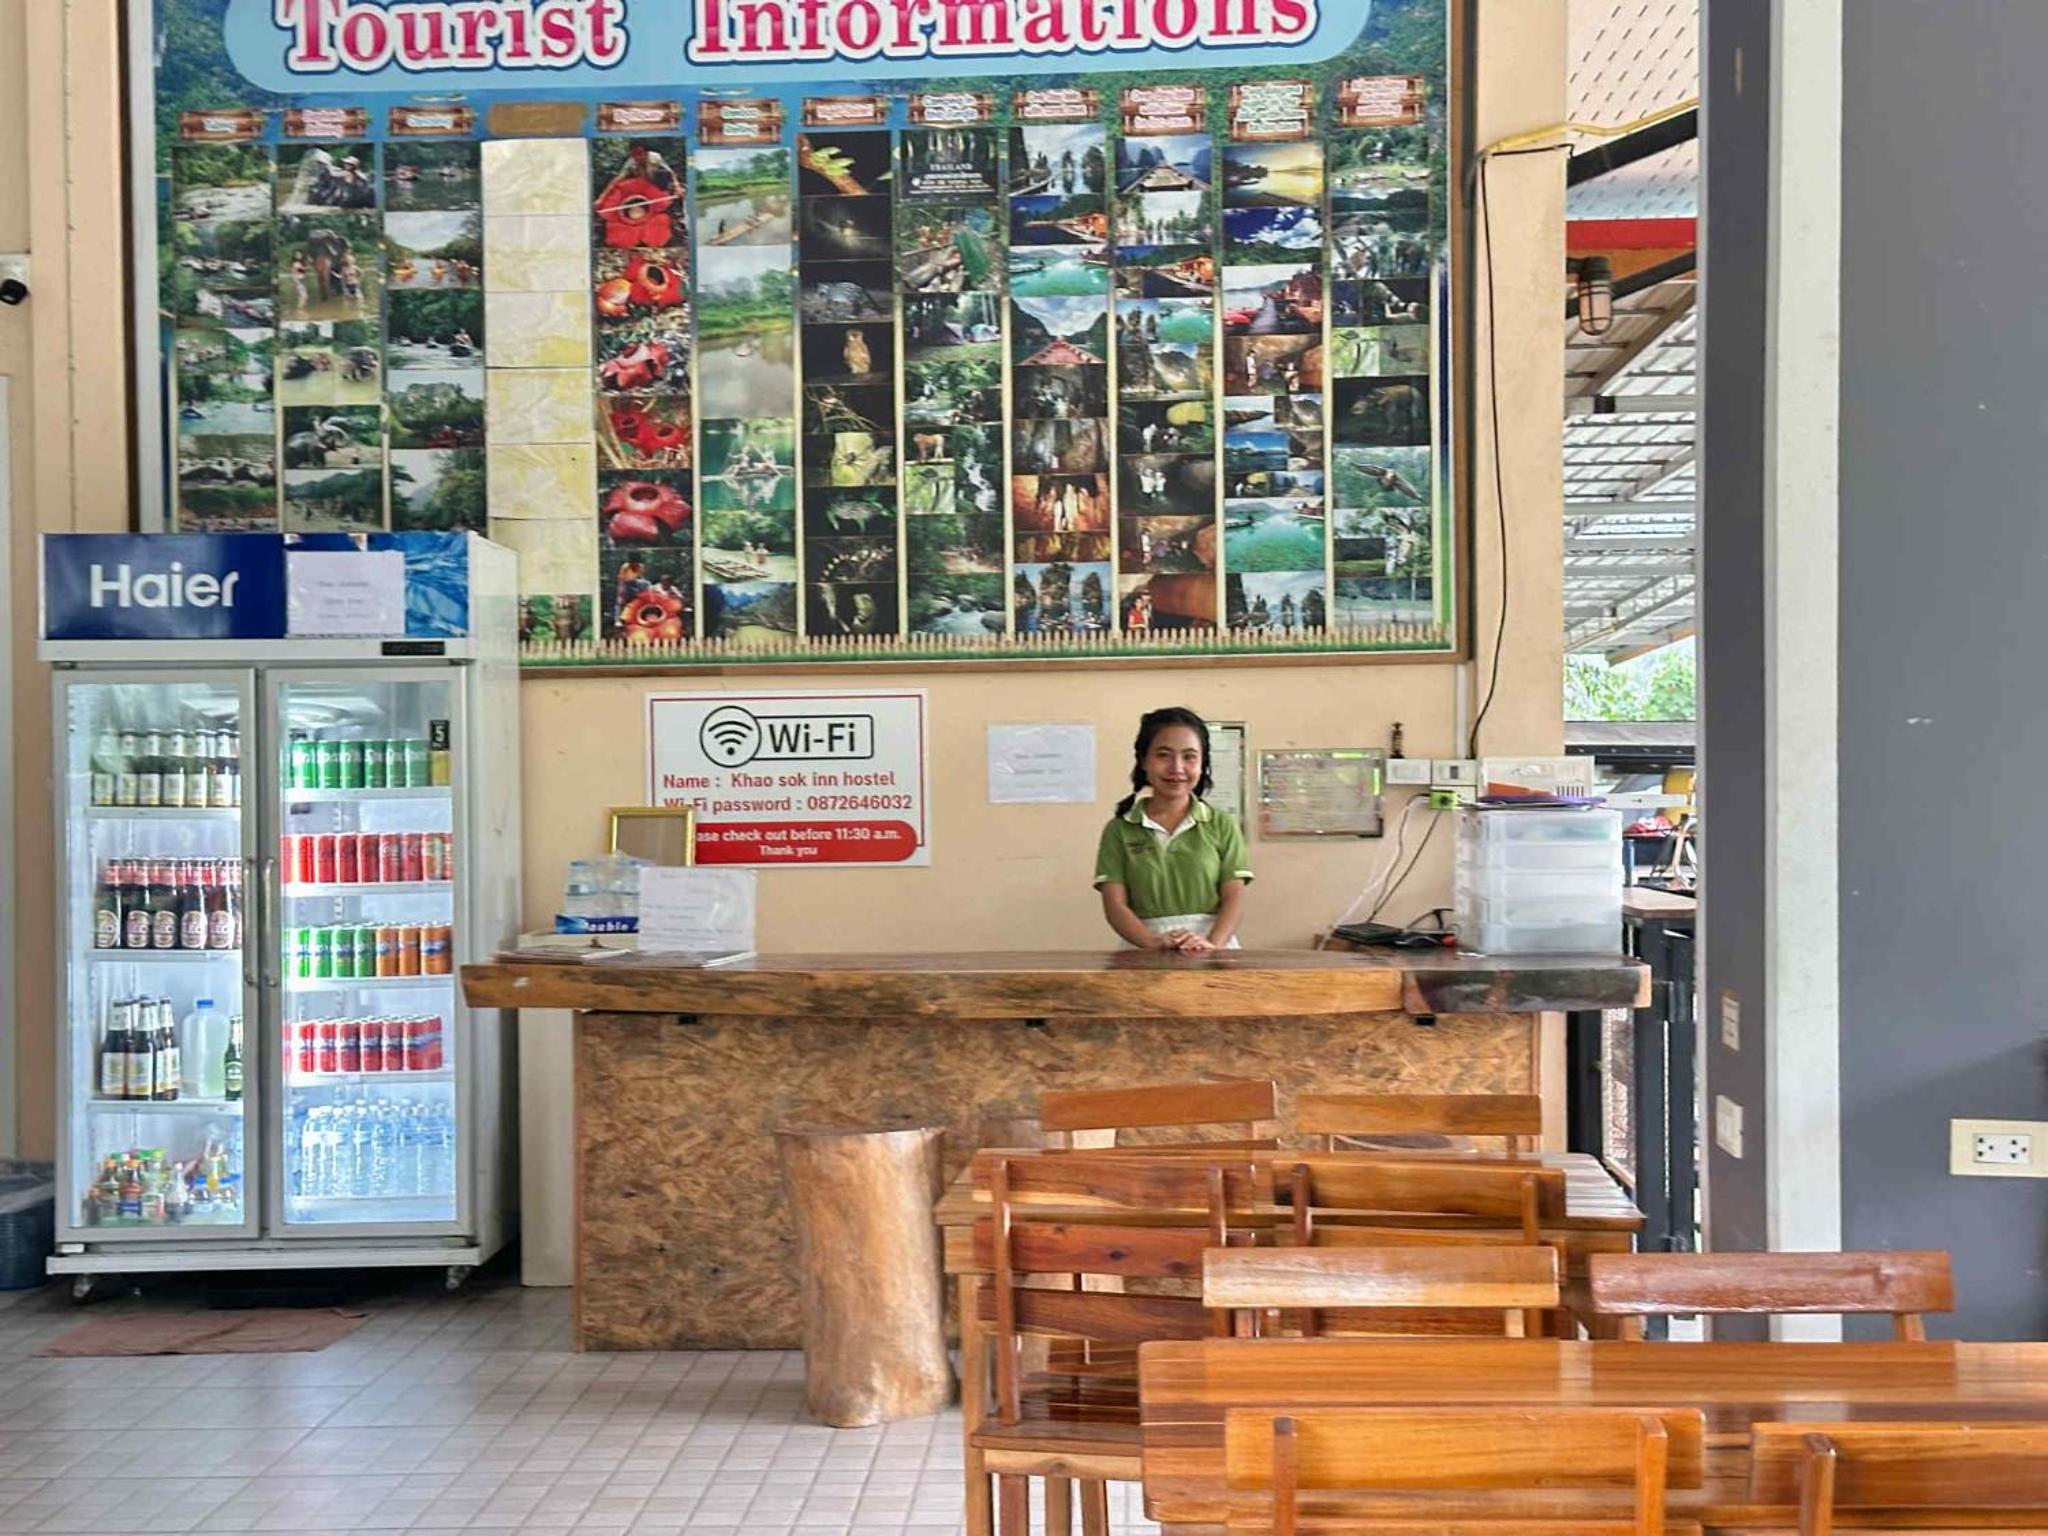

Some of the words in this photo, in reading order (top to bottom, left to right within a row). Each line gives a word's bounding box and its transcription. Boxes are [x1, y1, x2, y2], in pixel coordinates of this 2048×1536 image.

[278, 0, 622, 68] Tourist
[692, 0, 1312, 58] Informations
[90, 561, 240, 608] Haier
[768, 722, 856, 753] Wi-Fi
[663, 774, 710, 788] Name
[731, 772, 773, 787] Khao
[778, 772, 806, 787] sok
[812, 772, 838, 787] inn
[843, 771, 896, 786] hostel
[713, 796, 791, 815] password
[807, 794, 912, 810] 0872646032
[696, 832, 720, 841] ase
[722, 829, 762, 841] check
[764, 829, 788, 841] out
[790, 828, 832, 841] before
[835, 827, 870, 840] 11:30
[873, 829, 902, 840] a.m.
[760, 844, 795, 857] Thank
[796, 845, 818, 858] you
